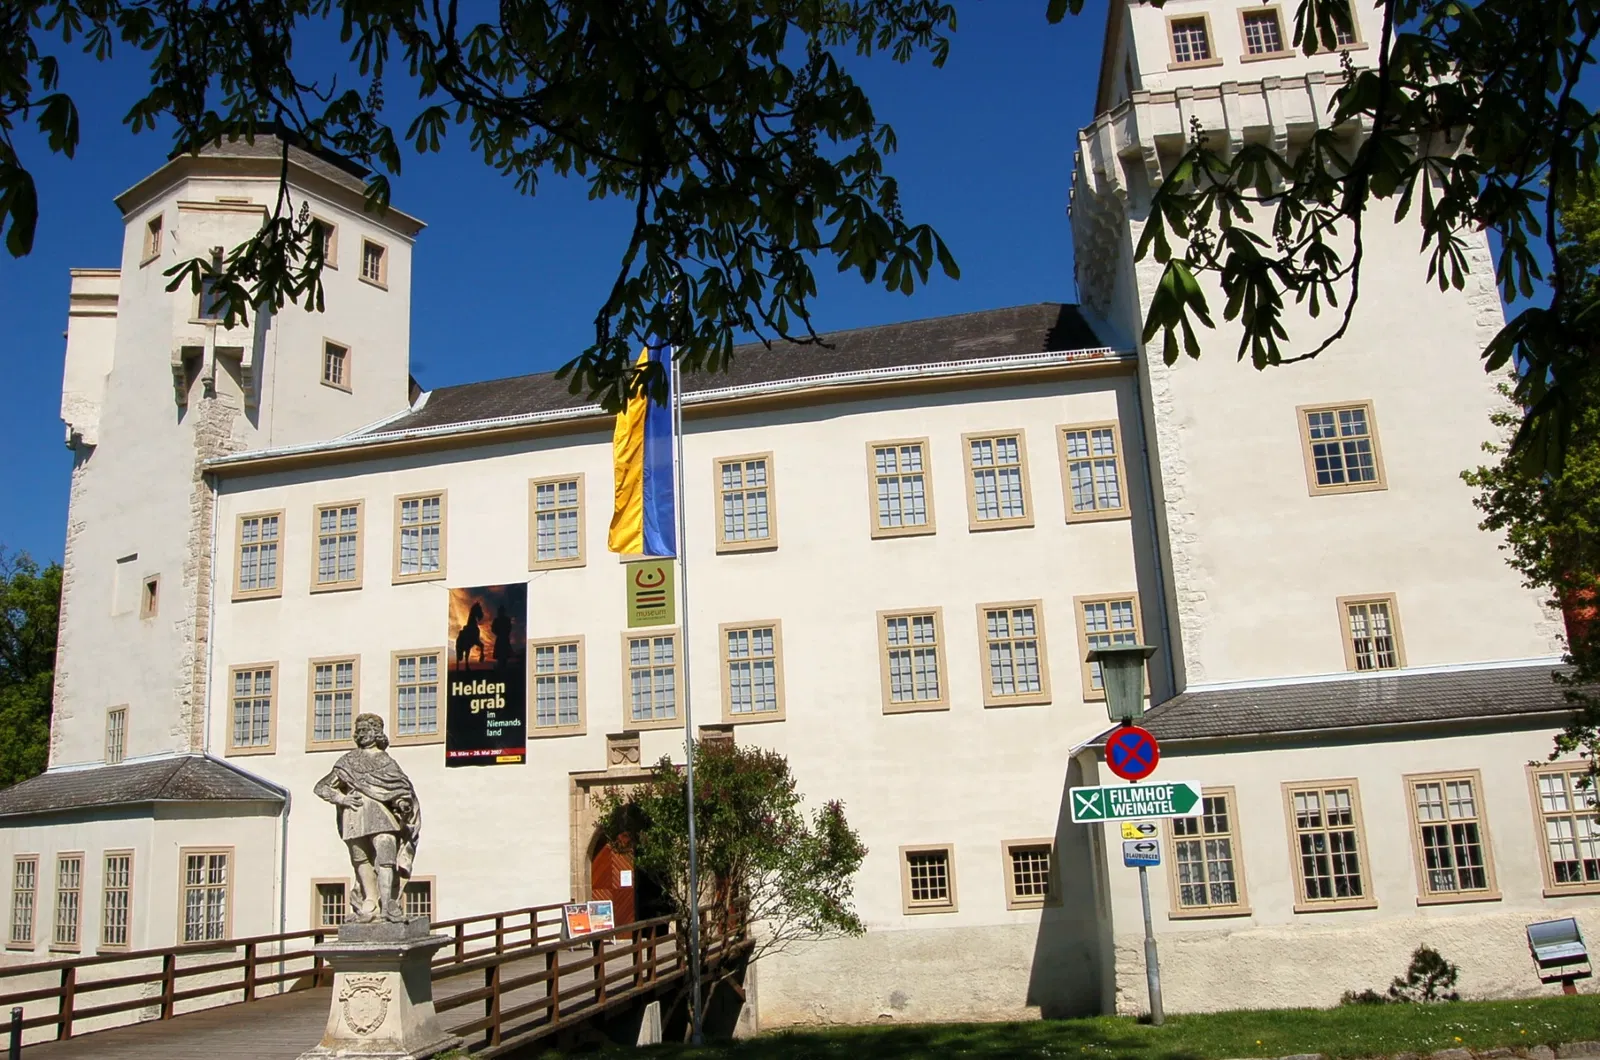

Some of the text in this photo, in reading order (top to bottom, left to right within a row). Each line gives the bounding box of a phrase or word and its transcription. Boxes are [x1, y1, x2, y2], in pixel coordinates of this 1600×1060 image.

[635, 609, 667, 617] museum
[452, 679, 505, 696] Helden
[470, 694, 505, 713] grab
[486, 718, 521, 727] Niemands
[486, 728, 502, 736] land
[1109, 786, 1174, 803] FILMHOF
[1111, 800, 1176, 816] WEIN4TEL
